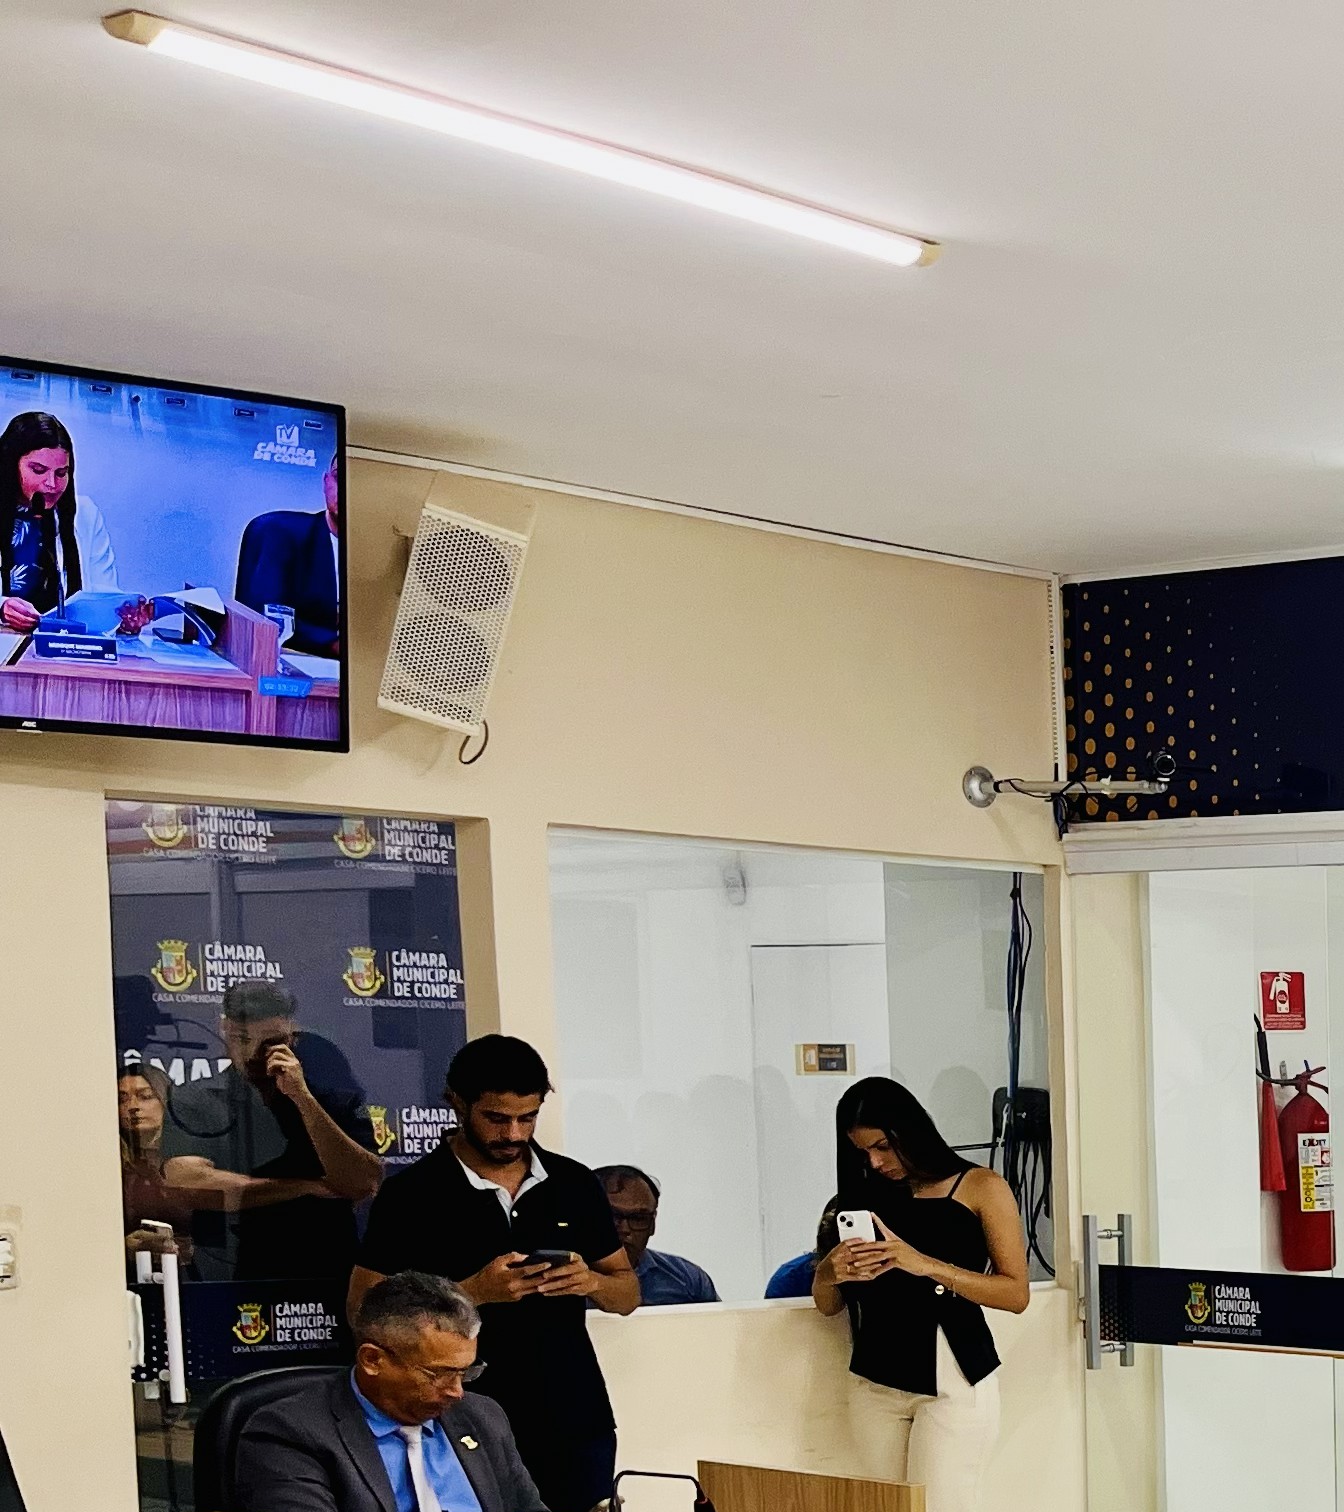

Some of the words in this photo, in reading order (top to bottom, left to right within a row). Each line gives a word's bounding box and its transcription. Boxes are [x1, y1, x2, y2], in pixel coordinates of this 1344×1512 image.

[197, 817, 274, 838] MUNICIPAL
[197, 834, 217, 850] DE
[220, 836, 268, 853] CONDE
[384, 829, 455, 850] MUNICIPAL
[384, 846, 403, 861] DE
[405, 847, 449, 865] CONDE
[205, 941, 265, 961] CÂMARA
[392, 949, 447, 967] CÂMARA
[206, 959, 284, 979] MUNICIPAL
[393, 966, 464, 985] MUNICIPAL
[207, 976, 226, 993] DE
[394, 981, 412, 997] DE
[414, 983, 458, 999] CONDE
[402, 1105, 457, 1123] CÂMARA
[404, 1138, 421, 1154] DE
[1215, 1284, 1250, 1299] CÂMARA
[275, 1302, 324, 1316] CÂMARA
[1215, 1299, 1261, 1313] MUNICIPAL
[276, 1315, 338, 1328] MUNICIPAL
[1216, 1312, 1227, 1324] DE
[1228, 1313, 1256, 1326] CONDE
[277, 1329, 291, 1342] DE
[294, 1328, 332, 1341] CONDE
